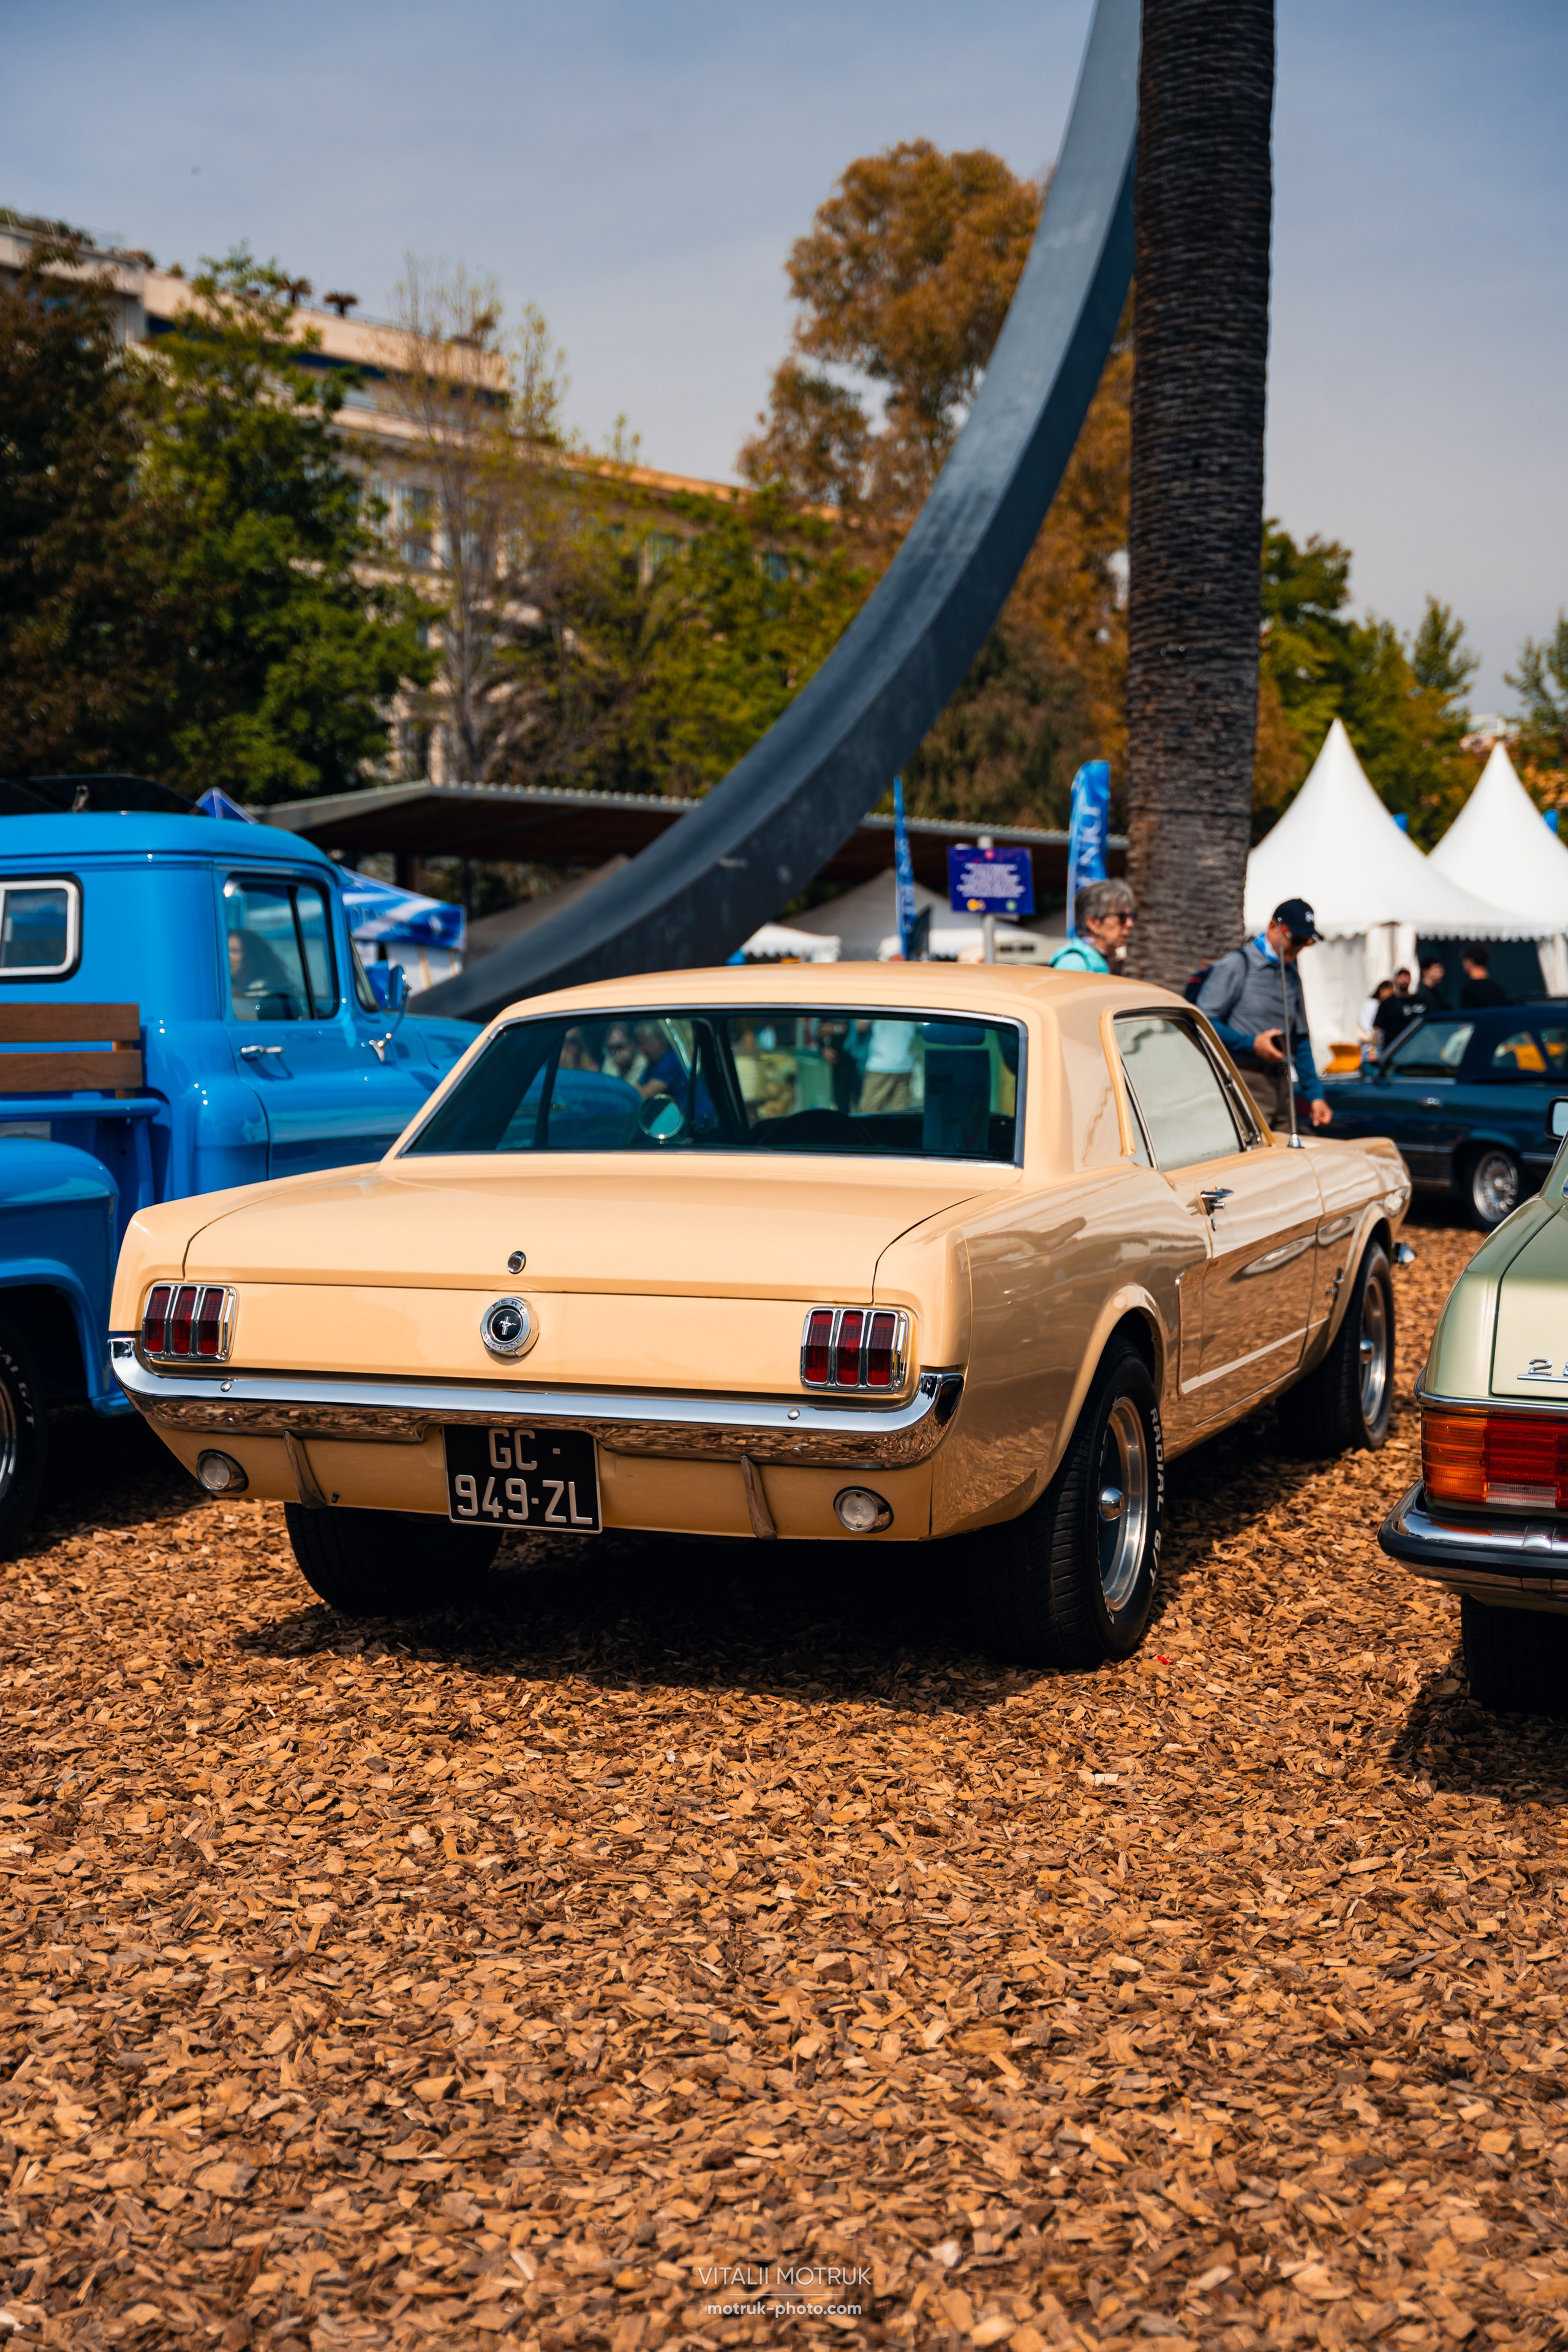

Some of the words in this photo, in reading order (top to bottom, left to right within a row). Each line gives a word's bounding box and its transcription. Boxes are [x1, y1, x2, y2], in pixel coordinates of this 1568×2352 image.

[491, 1300, 525, 1314] FORD
[483, 1331, 522, 1351] MUSTANG
[1528, 1358, 1568, 1376] 2
[1150, 1408, 1164, 1513] RADIAL
[454, 1474, 593, 1525] 949-ZL
[1149, 1529, 1162, 1588] G/T
